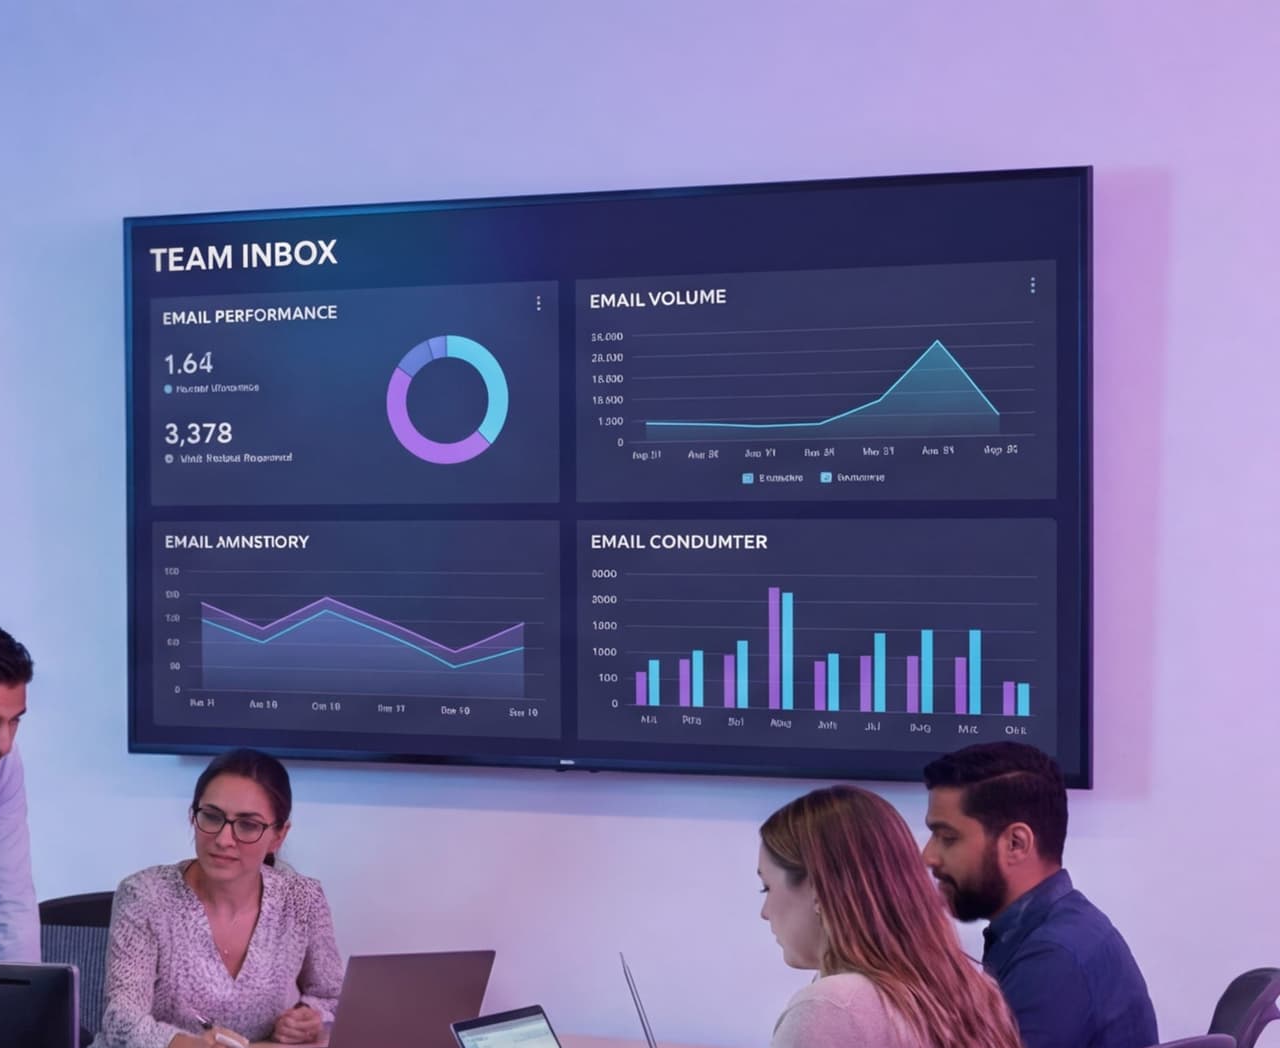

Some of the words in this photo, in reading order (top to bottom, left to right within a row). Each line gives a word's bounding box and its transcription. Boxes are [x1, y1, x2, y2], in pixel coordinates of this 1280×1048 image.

[149, 245, 233, 273] TEAM
[242, 239, 338, 269] INBOX
[590, 292, 646, 309] EMAIL
[648, 288, 728, 306] VOLUME
[163, 310, 212, 326] EMAIL
[215, 305, 338, 324] PERFORMANCE
[164, 351, 214, 375] 1.64
[164, 422, 233, 448] 3,378
[617, 437, 624, 447] 0
[165, 535, 214, 549] EMAIL
[591, 534, 646, 549] EMAIL
[649, 534, 768, 549] CONDUMTER
[592, 647, 617, 657] 1000
[598, 673, 618, 683] 100
[611, 699, 619, 708] 0
